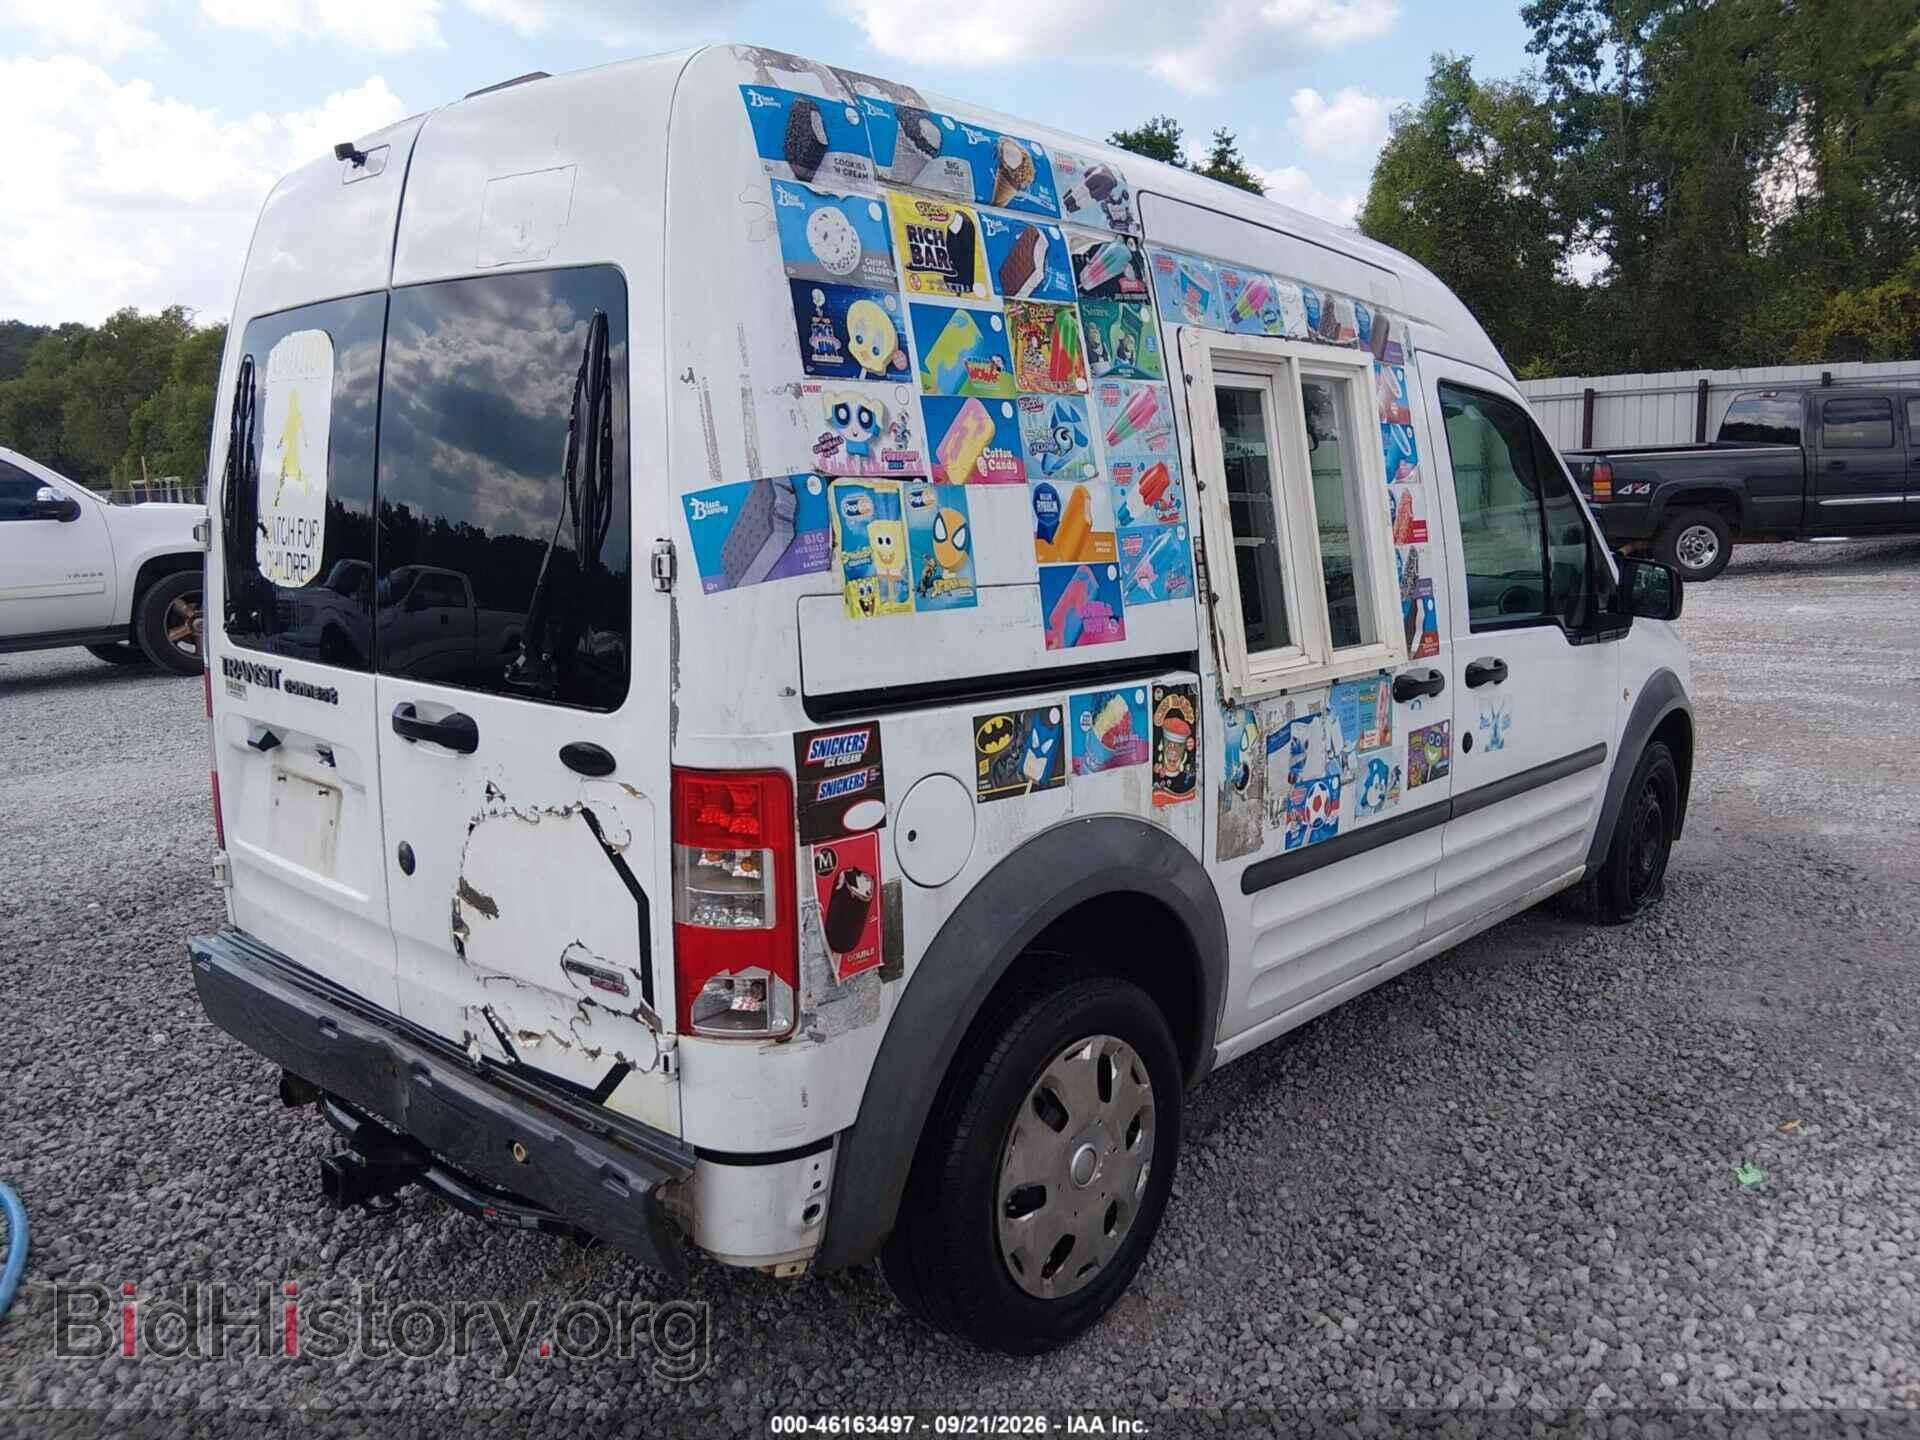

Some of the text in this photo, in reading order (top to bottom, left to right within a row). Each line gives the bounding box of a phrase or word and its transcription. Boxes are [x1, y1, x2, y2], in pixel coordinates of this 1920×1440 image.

[843, 167, 869, 179] CREAM
[906, 224, 946, 249] RICH
[910, 243, 953, 271] BAR
[983, 447, 1014, 460] Cotton
[988, 459, 1018, 474] Candy
[804, 533, 825, 545] BIG
[220, 656, 282, 690] TRANSIT
[284, 679, 339, 705] connect
[810, 733, 867, 759] SNICKERS
[824, 752, 863, 768] ICE CREAM
[820, 772, 867, 799] SNICKERS
[847, 947, 875, 962] DOUBLE
